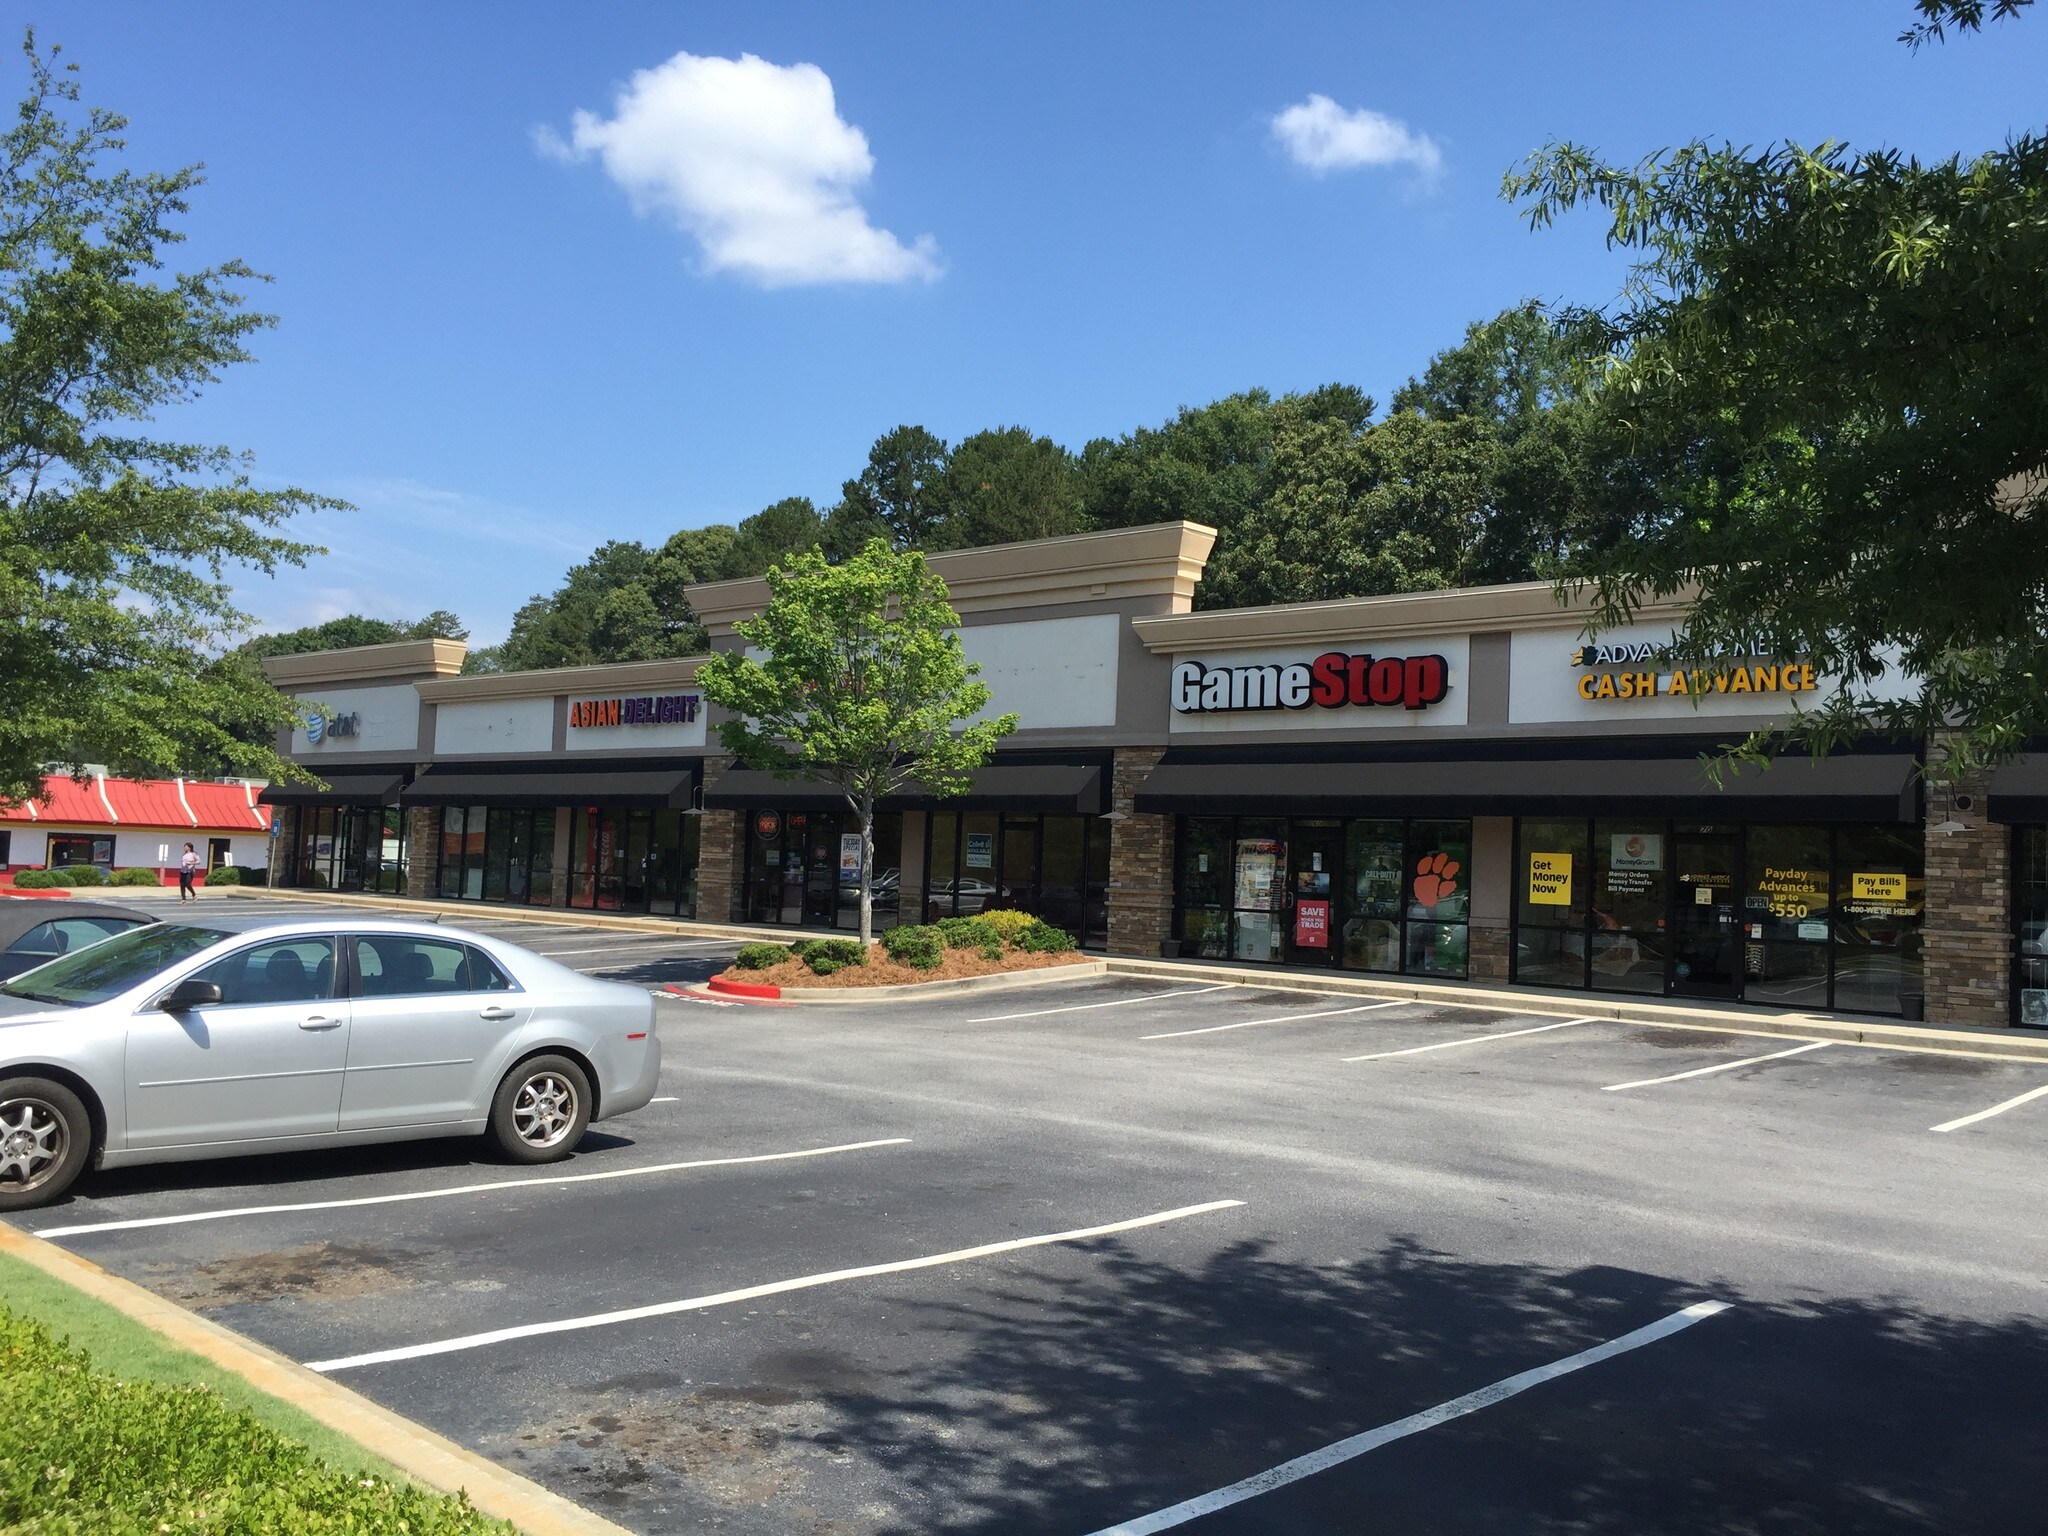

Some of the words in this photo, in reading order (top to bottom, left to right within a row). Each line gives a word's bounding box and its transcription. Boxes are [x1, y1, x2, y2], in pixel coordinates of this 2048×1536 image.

[1170, 652, 1447, 712] GameStop
[1578, 671, 1656, 699] CASH
[1668, 664, 1818, 696] ADVANCE
[570, 699, 621, 728] ASIAN
[624, 695, 699, 725] DELIGHT
[1533, 861, 1552, 870] Get
[1533, 873, 1568, 884] Money
[1765, 868, 1808, 881] Payday
[1608, 878, 1628, 886] Money
[1759, 881, 1816, 893] Advances
[1858, 878, 1876, 887] Pay
[1879, 878, 1901, 886] Bills
[1532, 884, 1557, 893] Now
[1747, 897, 1768, 908] OPEN
[1774, 893, 1784, 902] up
[1789, 893, 1799, 901] to
[1300, 907, 1325, 916] SAVE
[1769, 903, 1808, 918] $550
[1843, 906, 1892, 914] 1-800-WE'RE
[1301, 921, 1325, 929] TRADE
